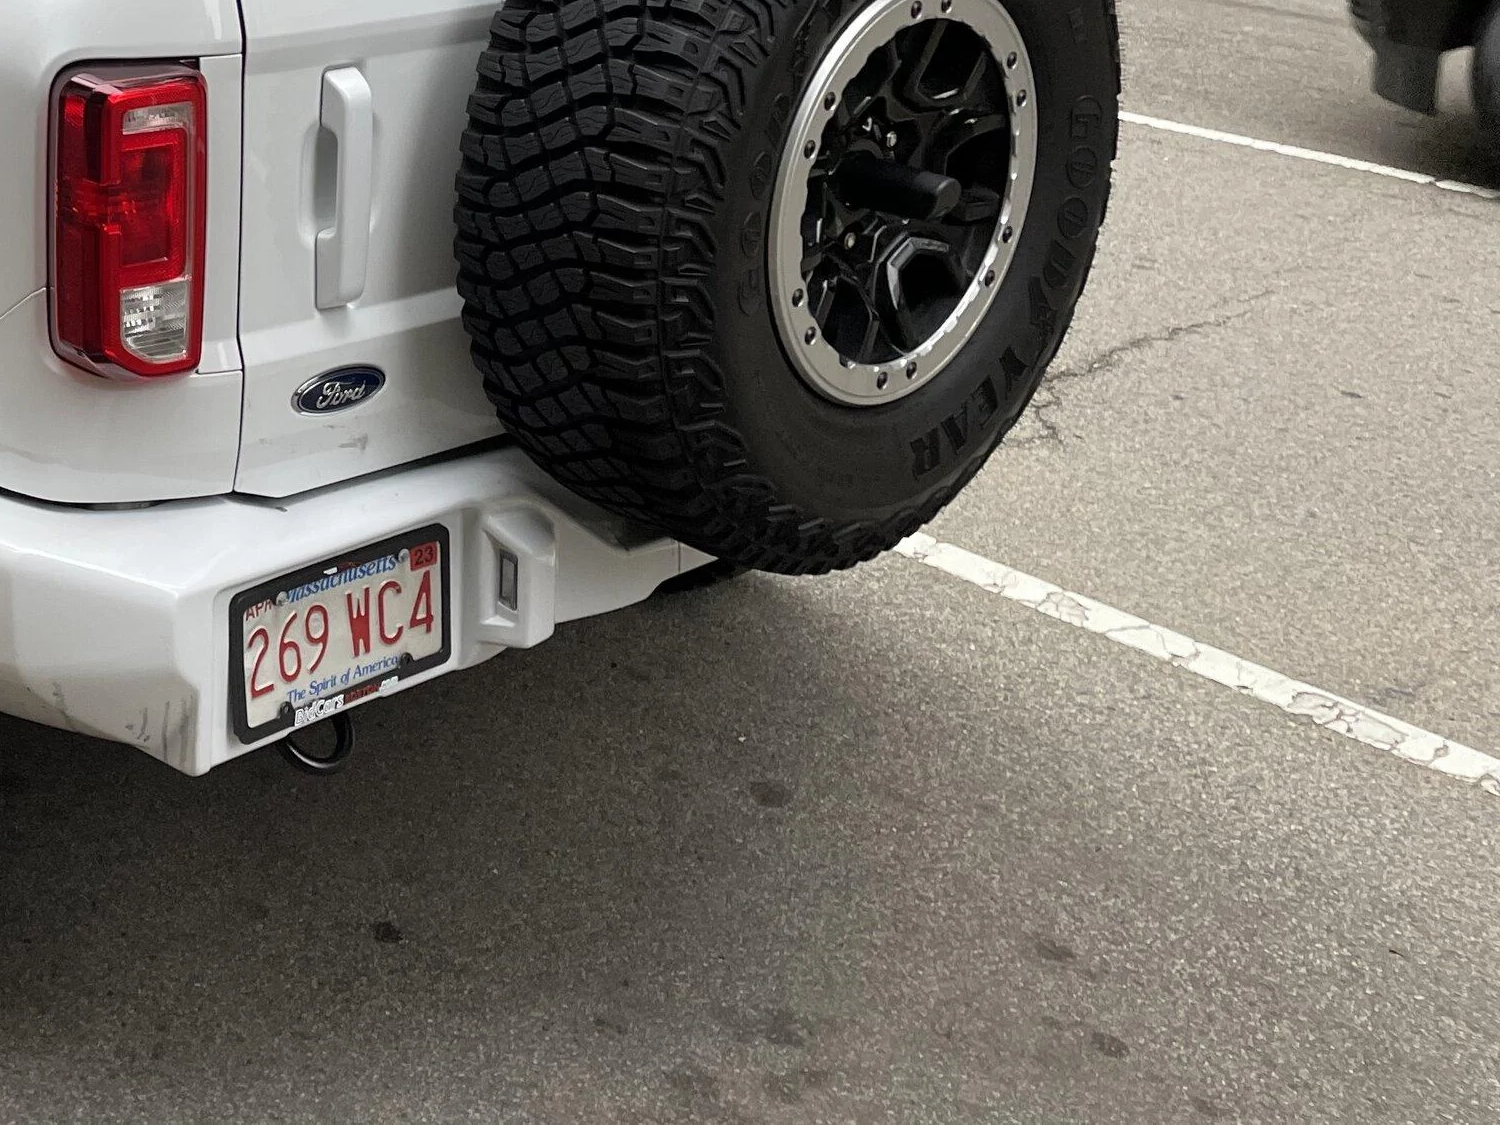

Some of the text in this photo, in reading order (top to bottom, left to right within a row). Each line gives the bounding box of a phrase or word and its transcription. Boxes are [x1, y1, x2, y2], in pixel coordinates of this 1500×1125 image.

[316, 379, 366, 409] Ford
[414, 548, 437, 566] 23
[247, 570, 435, 700] 269 WC4
[287, 655, 399, 702] The Spirit of America
